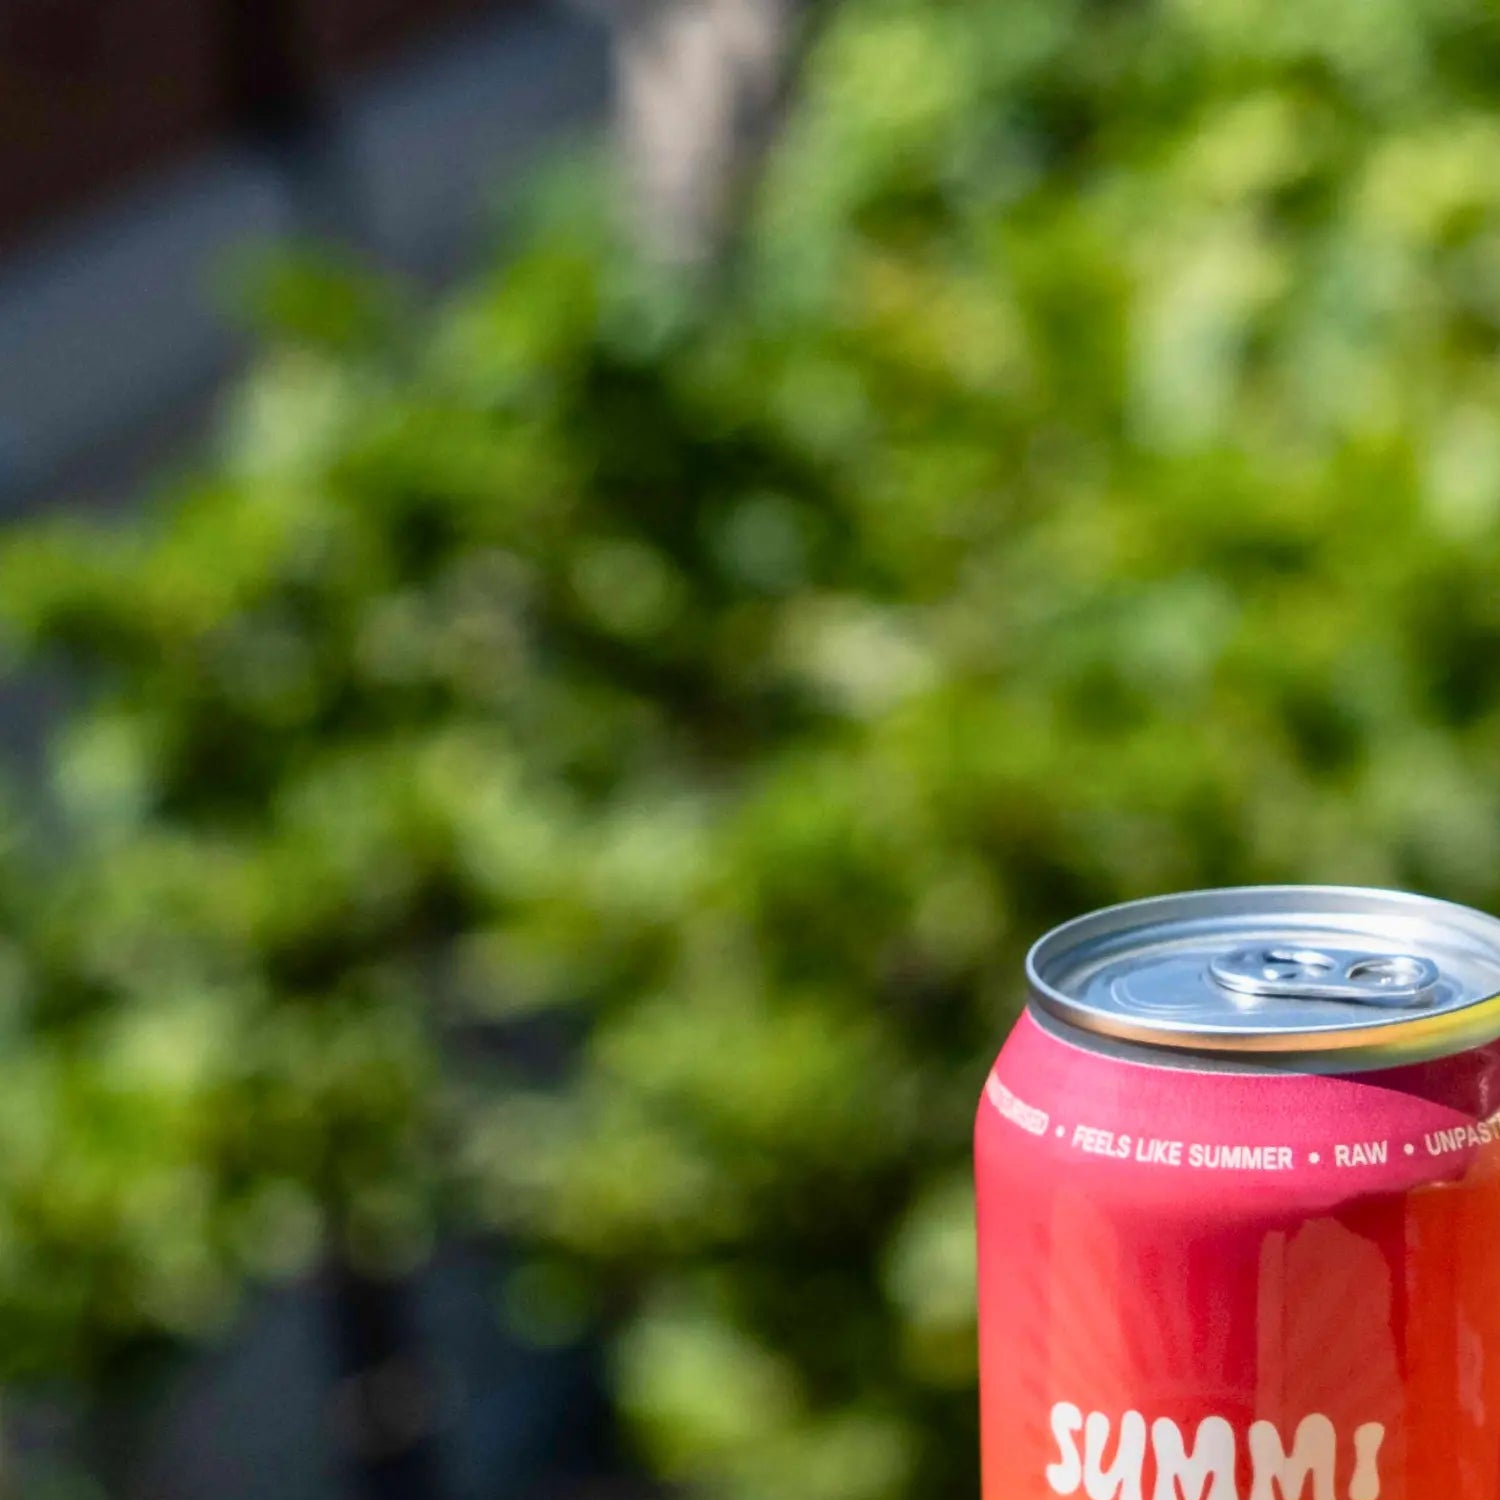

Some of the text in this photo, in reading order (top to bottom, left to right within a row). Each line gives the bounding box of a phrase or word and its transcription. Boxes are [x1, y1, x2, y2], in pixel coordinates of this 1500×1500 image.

[1072, 1124, 1132, 1159] FEELS
[1135, 1138, 1183, 1166] LIKE
[1188, 1143, 1293, 1170] SUMMER
[1334, 1140, 1388, 1168] RAW
